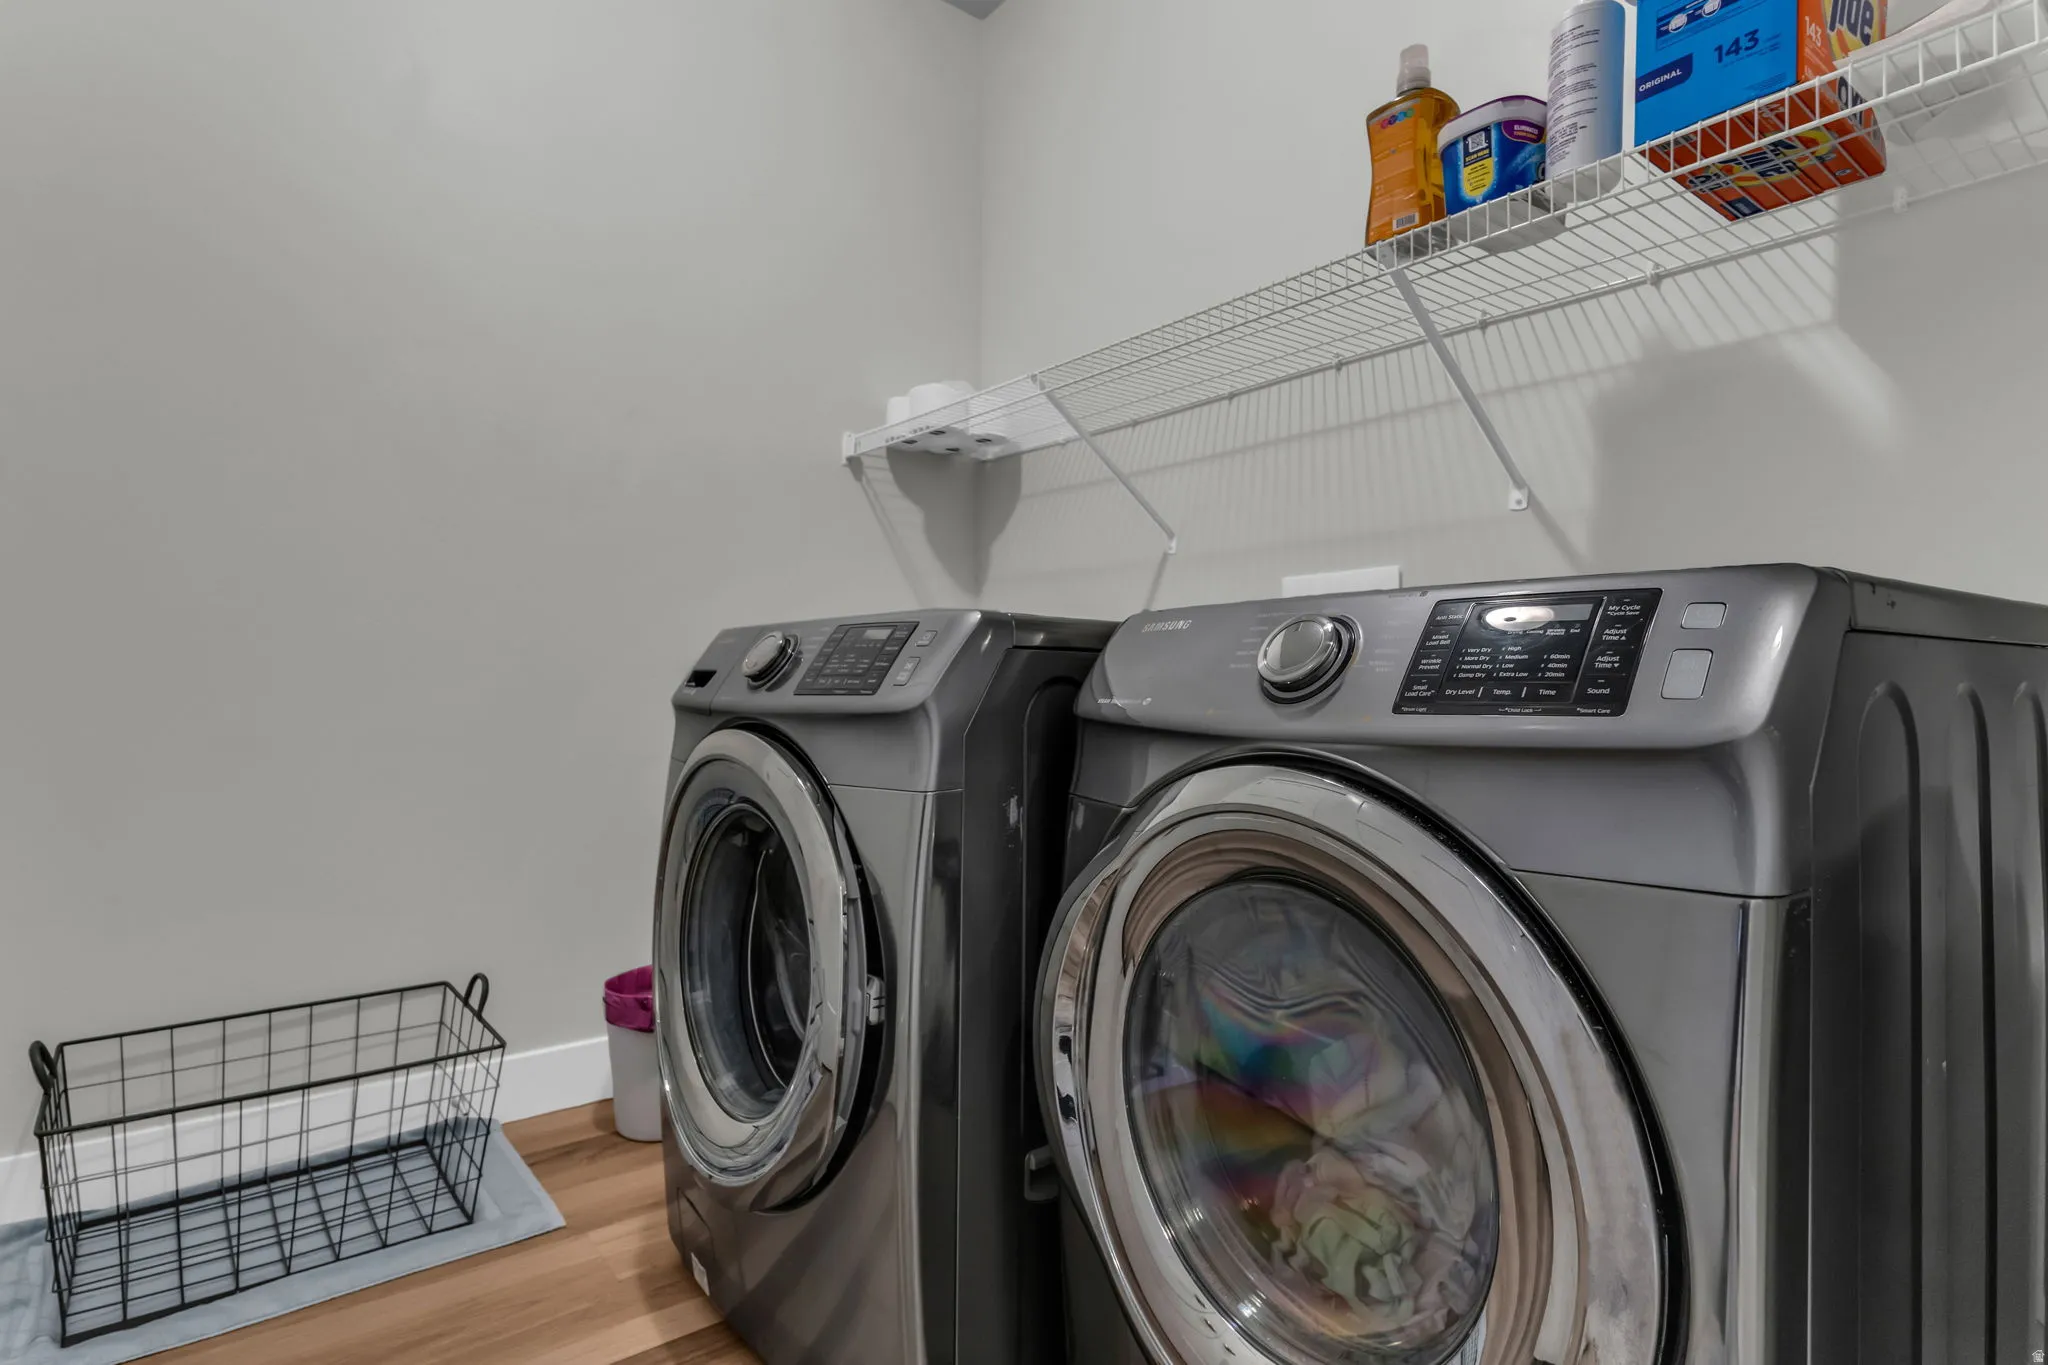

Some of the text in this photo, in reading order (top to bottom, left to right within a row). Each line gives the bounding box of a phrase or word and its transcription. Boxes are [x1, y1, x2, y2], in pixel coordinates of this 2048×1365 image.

[1804, 15, 1822, 47] 143
[1714, 28, 1760, 64] 143
[1639, 68, 1683, 93] ORIGINAL
[1142, 620, 1192, 633] SAMSUNG
